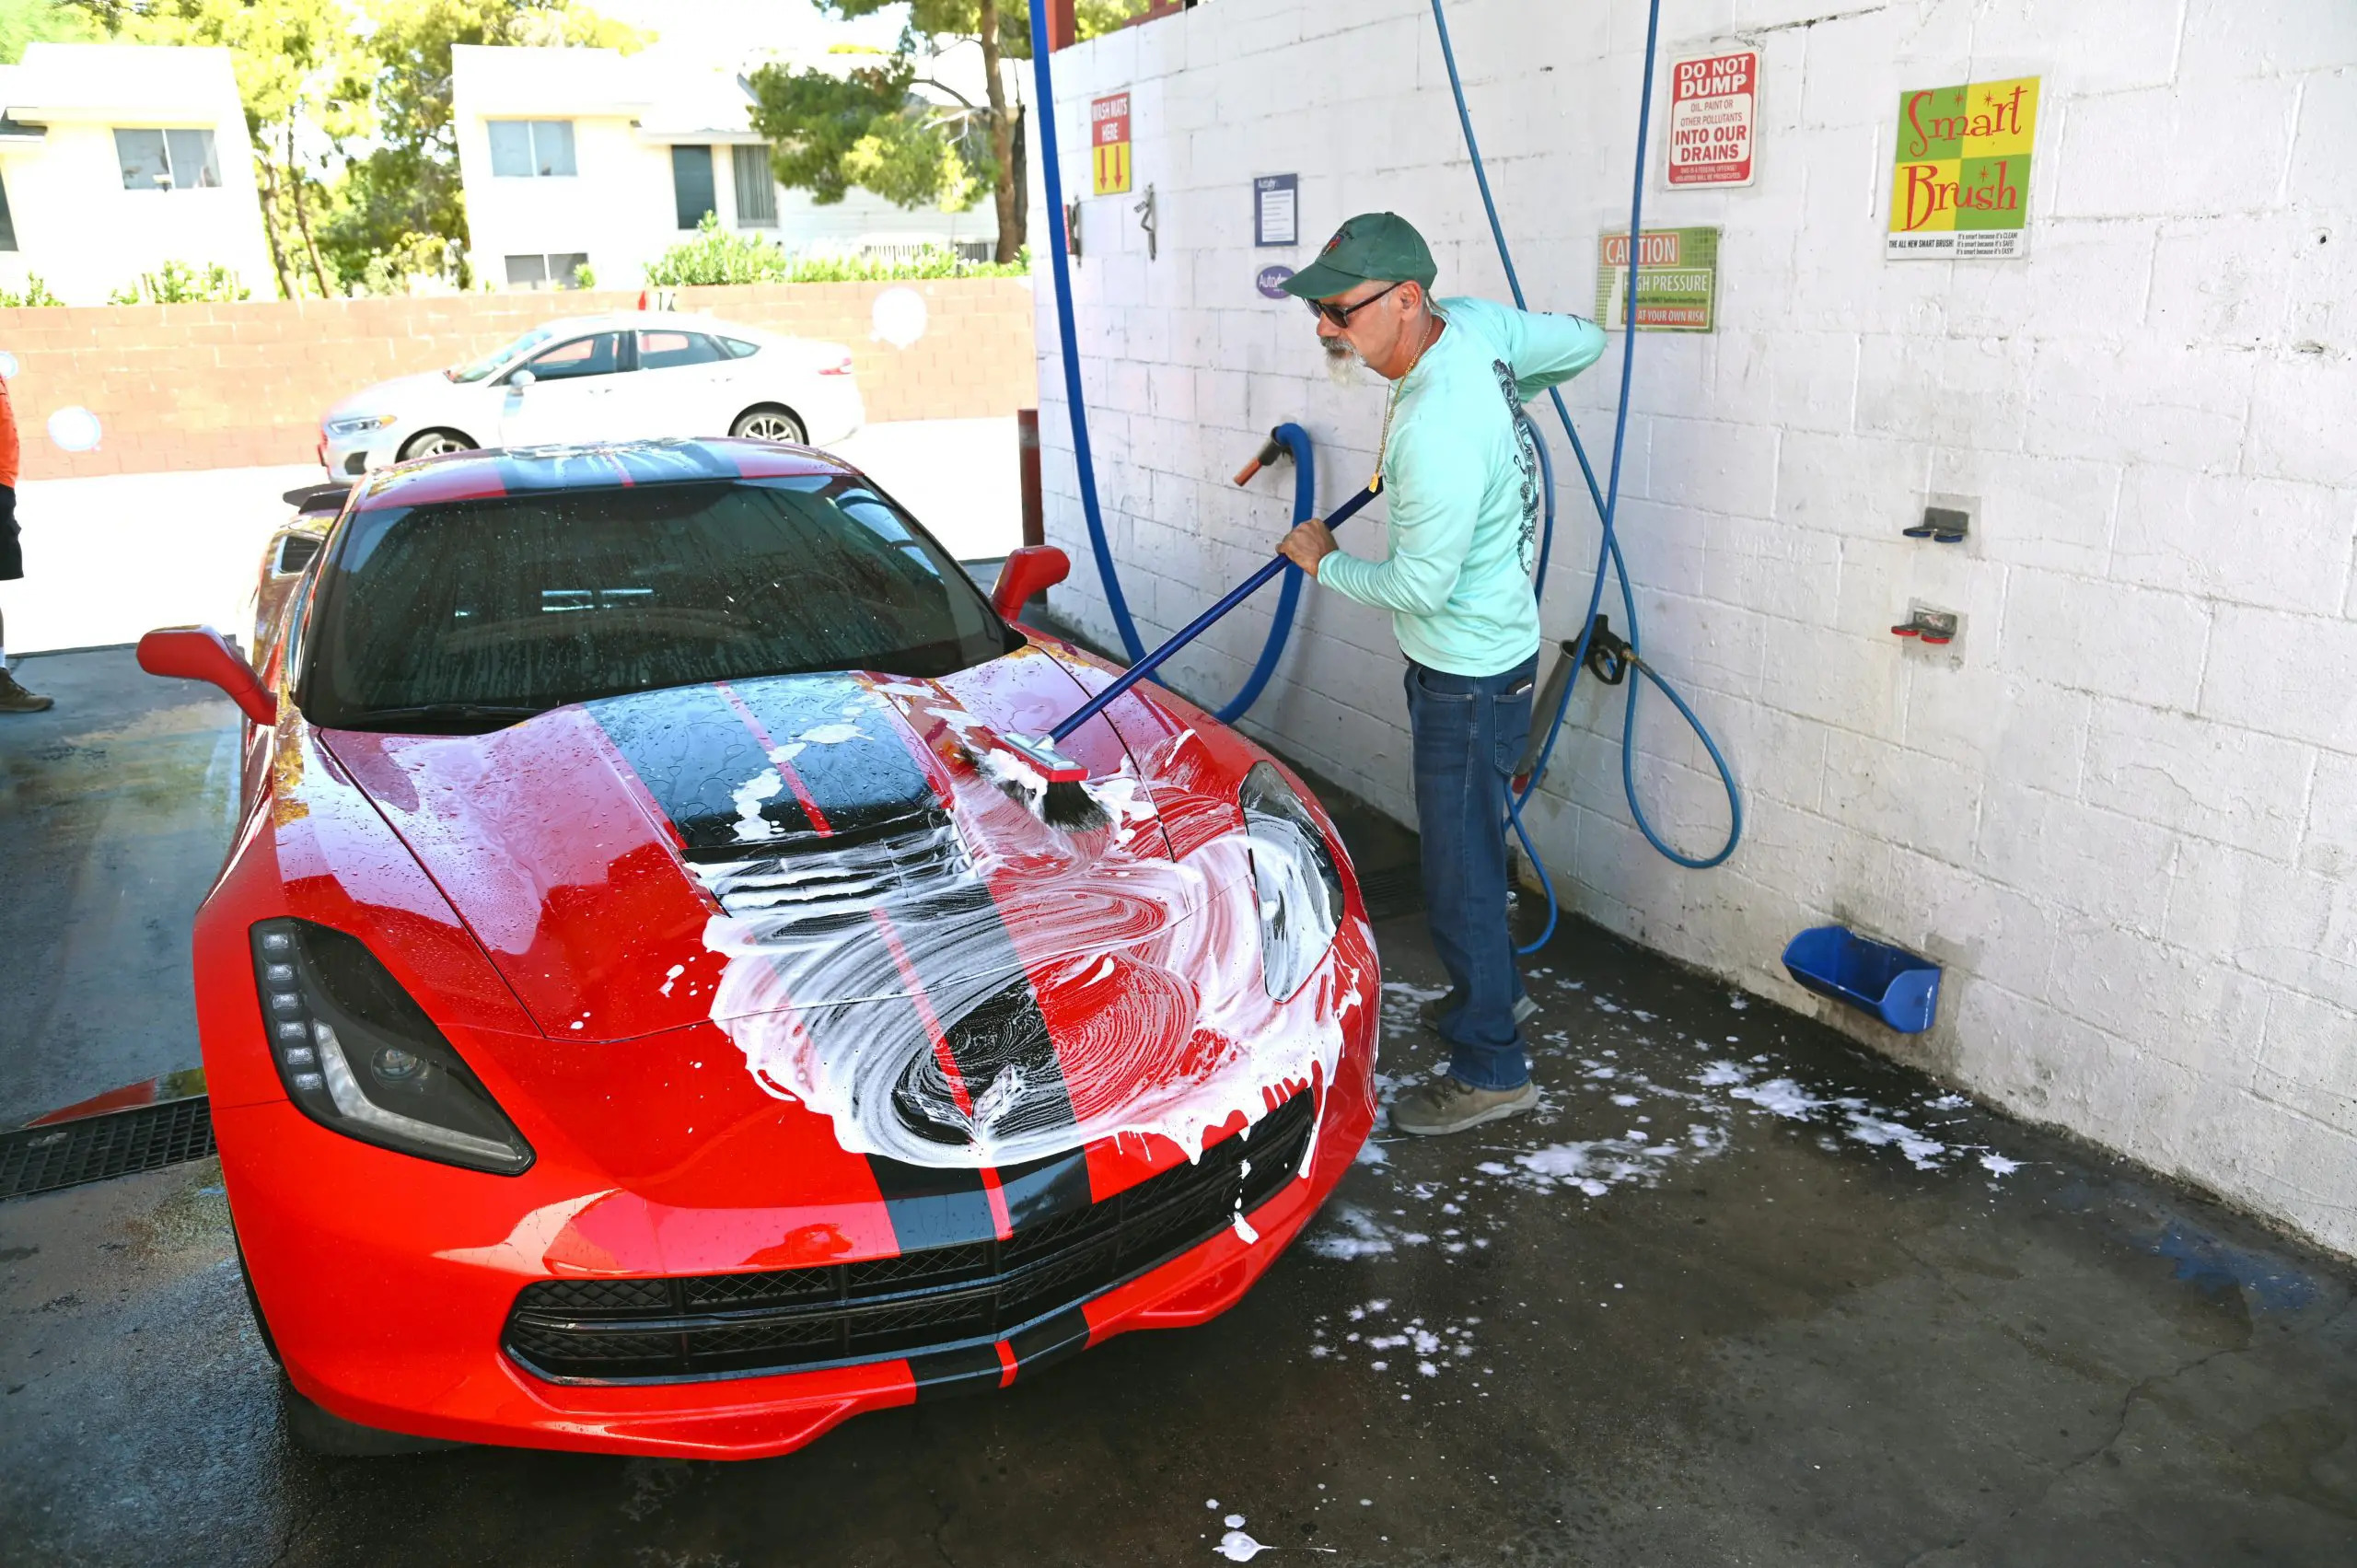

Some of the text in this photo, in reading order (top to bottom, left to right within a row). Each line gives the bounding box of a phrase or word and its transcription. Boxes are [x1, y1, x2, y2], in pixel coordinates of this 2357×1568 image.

[1680, 56, 1749, 80] DO NOT
[1679, 74, 1747, 99] DUMP
[1704, 100, 1723, 111] PAINT
[1724, 99, 1734, 110] OR
[1680, 112, 1743, 127] OTHER POLLUTANTS
[1908, 85, 2028, 157] Smart
[1675, 124, 1747, 145] INTO OUR
[1680, 144, 1739, 163] DRAINS
[1900, 160, 2018, 232] Brush
[1888, 240, 1898, 249] THE
[1898, 239, 1907, 249] ALL
[1908, 239, 1918, 248] NEW
[1919, 239, 1935, 248] SMART
[1623, 274, 1708, 292] HGH PRESSURE
[1637, 309, 1647, 320] AT
[1647, 309, 1667, 321] YOUR
[1668, 309, 1686, 322] OWN
[1687, 310, 1705, 322] RISK
